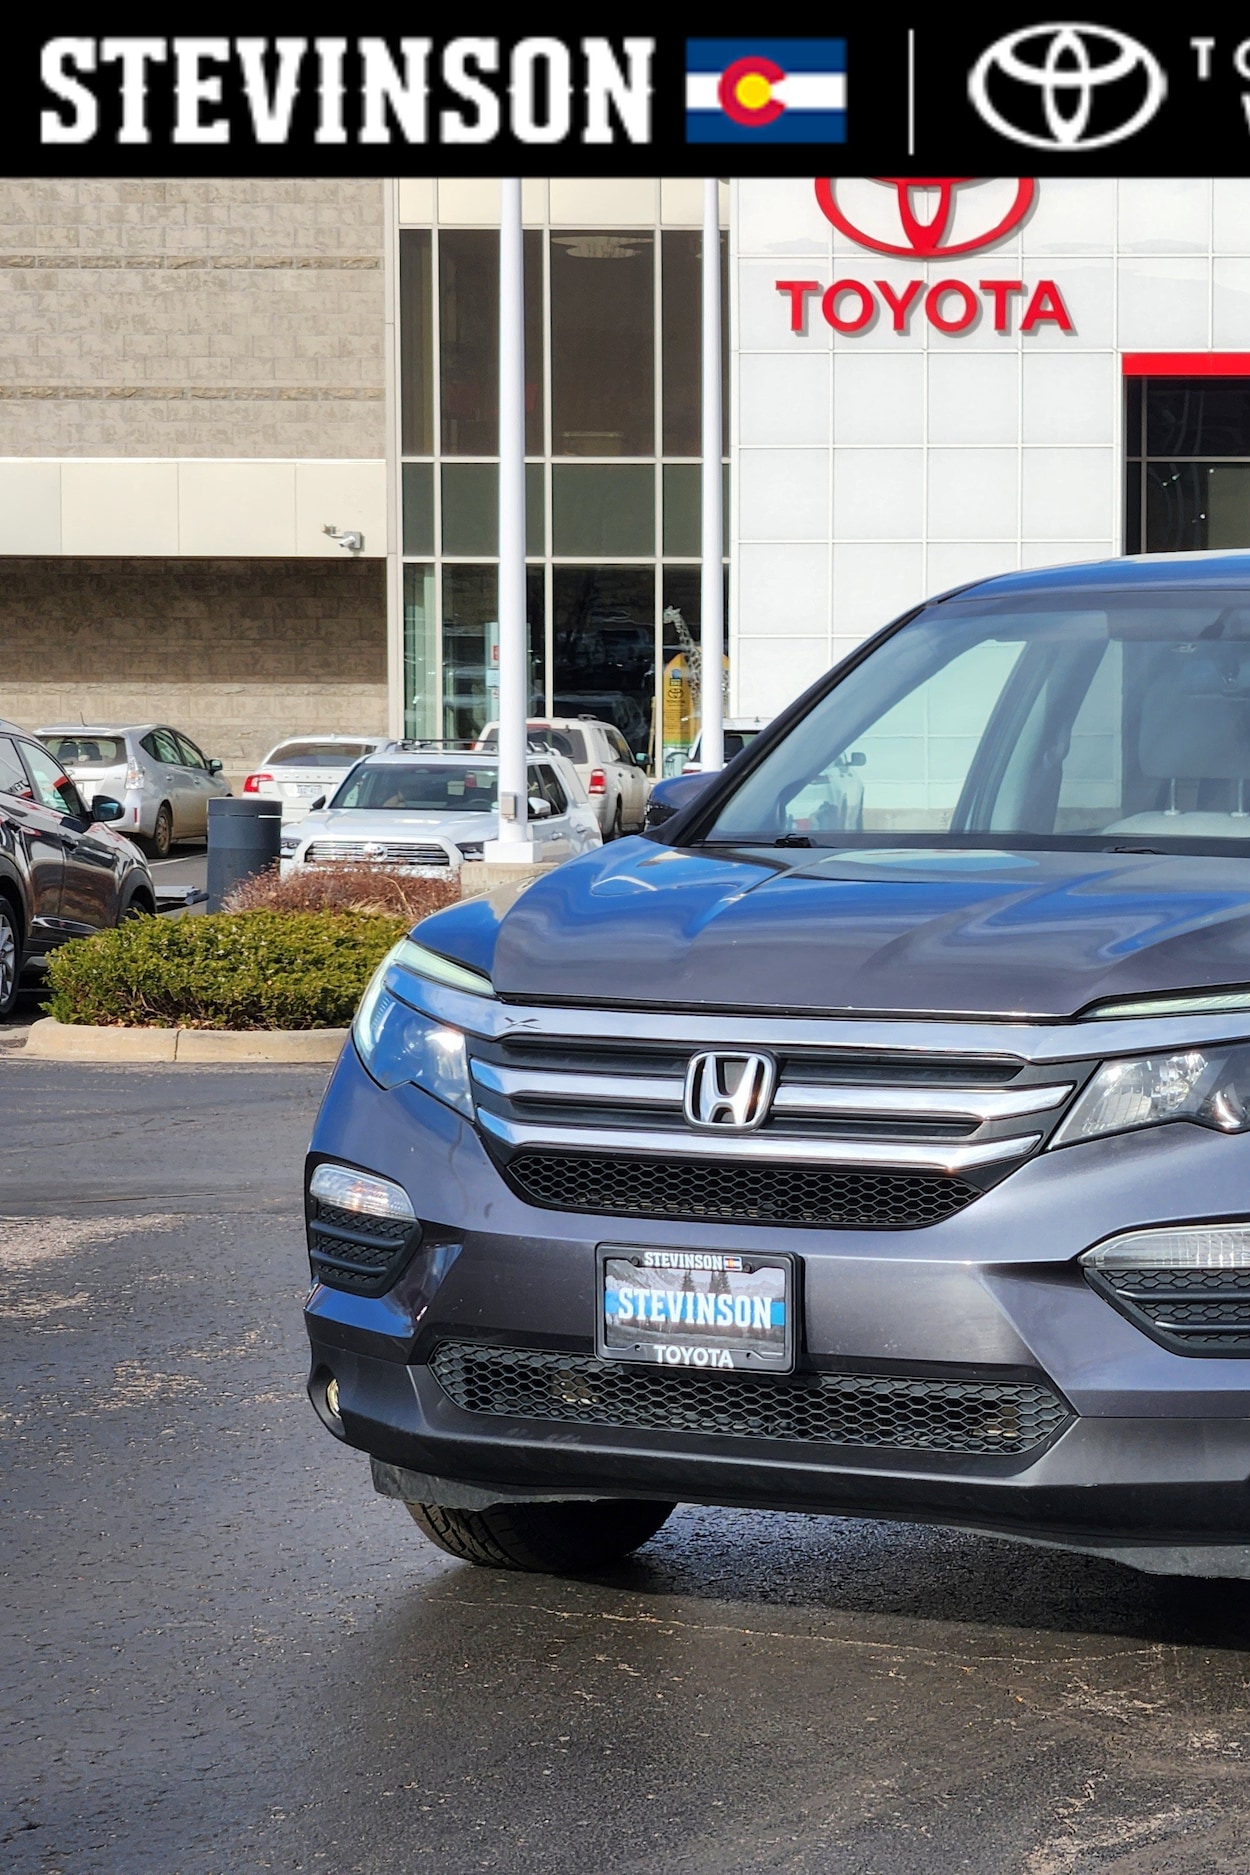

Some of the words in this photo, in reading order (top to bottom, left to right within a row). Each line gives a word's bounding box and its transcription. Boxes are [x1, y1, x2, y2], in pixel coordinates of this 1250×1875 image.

[776, 279, 1073, 334] TOYOTA
[643, 1251, 724, 1271] STEVINSON
[617, 1287, 773, 1329] STEVINSON
[653, 1344, 735, 1369] TOYOTA
